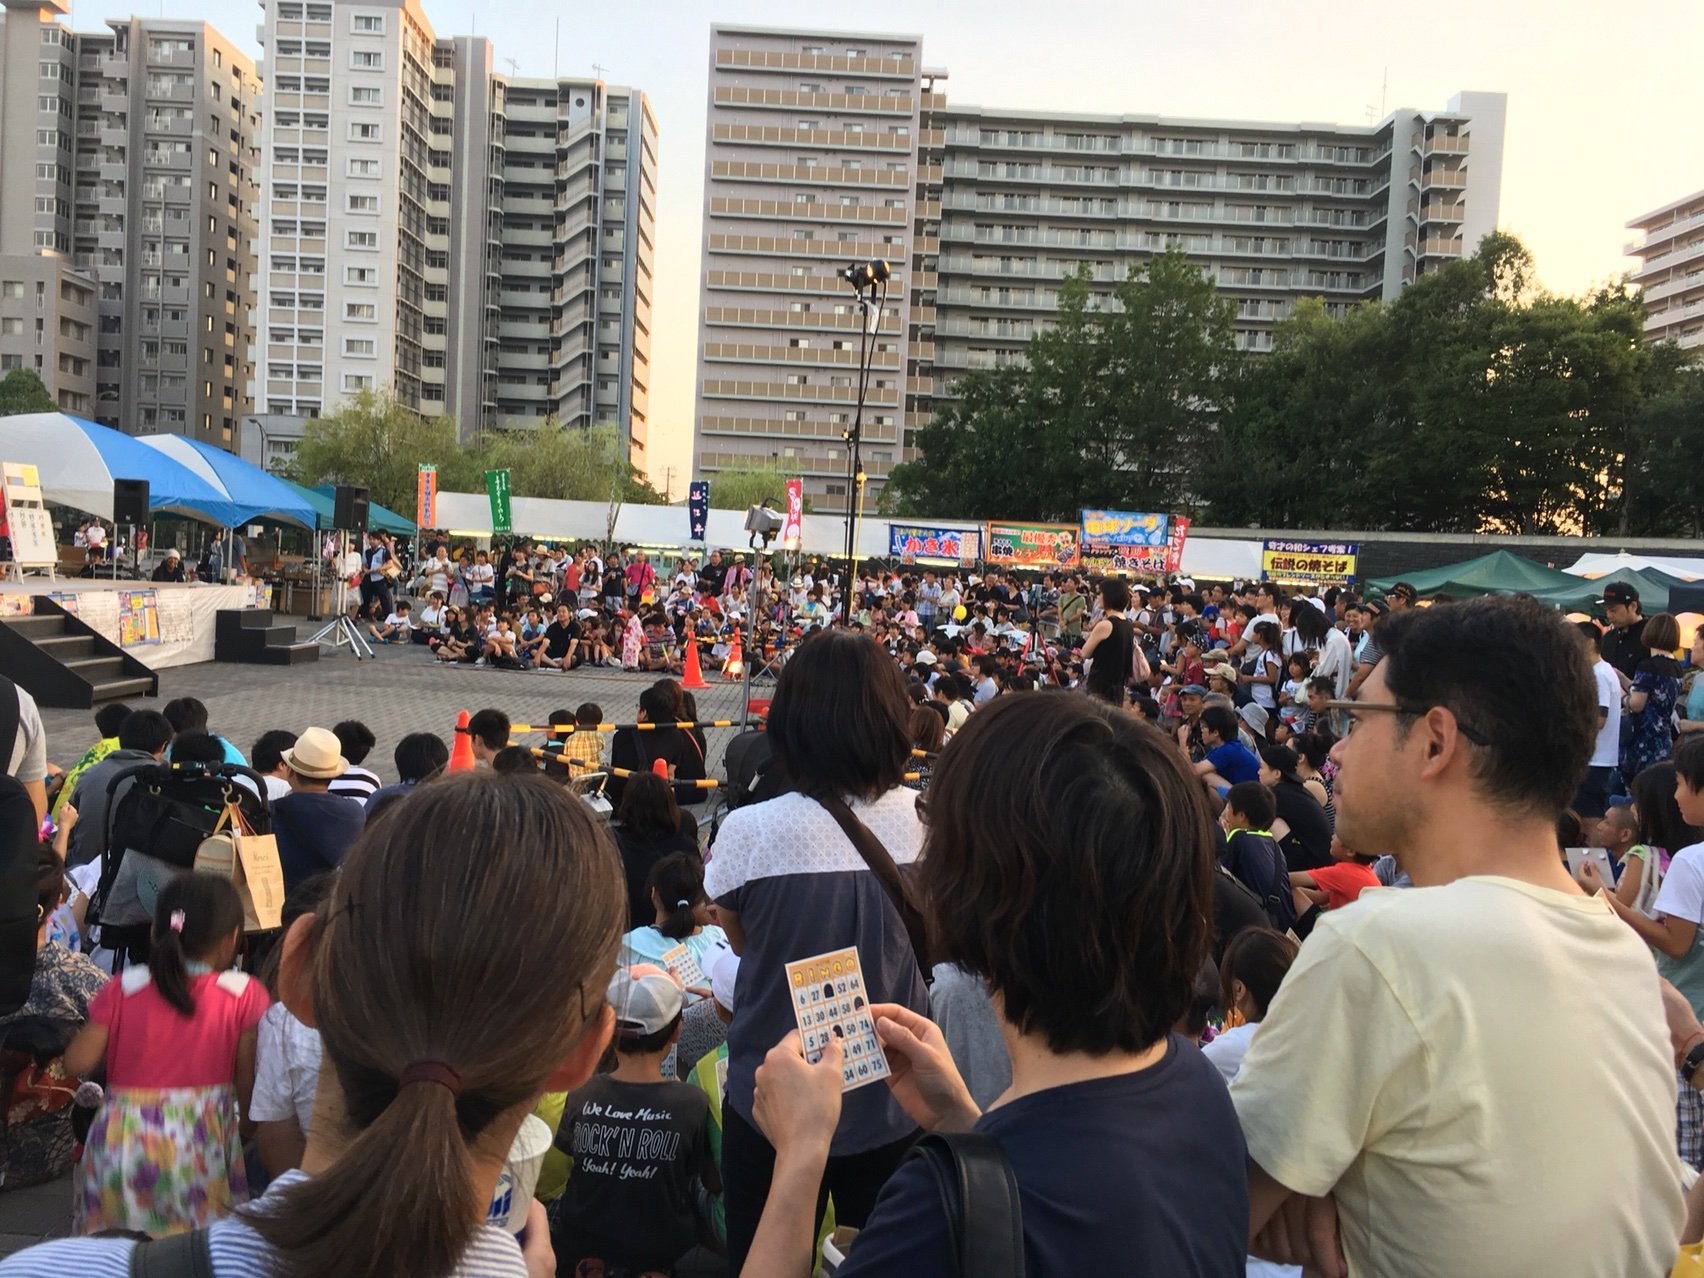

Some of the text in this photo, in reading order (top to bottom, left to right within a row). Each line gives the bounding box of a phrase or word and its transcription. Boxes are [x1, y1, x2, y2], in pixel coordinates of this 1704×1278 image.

[905, 535, 959, 557] かき氷
[1113, 554, 1167, 571] 焼きそば
[1270, 557, 1348, 573] 伝説の焼そば
[793, 957, 856, 987] BINGO
[811, 990, 819, 1001] 27
[837, 983, 847, 993] 52
[850, 979, 859, 990] 64
[802, 1003, 851, 1027] 13 30 44 58
[809, 1019, 869, 1047] 5 28 50 74
[852, 1043, 862, 1057] 49
[866, 1039, 875, 1052] 71
[844, 1060, 882, 1081] 34 60 75
[582, 1100, 672, 1121] We Love Music
[636, 1128, 680, 1161] ROLL
[582, 1157, 658, 1180] Yeah! Yeah!
